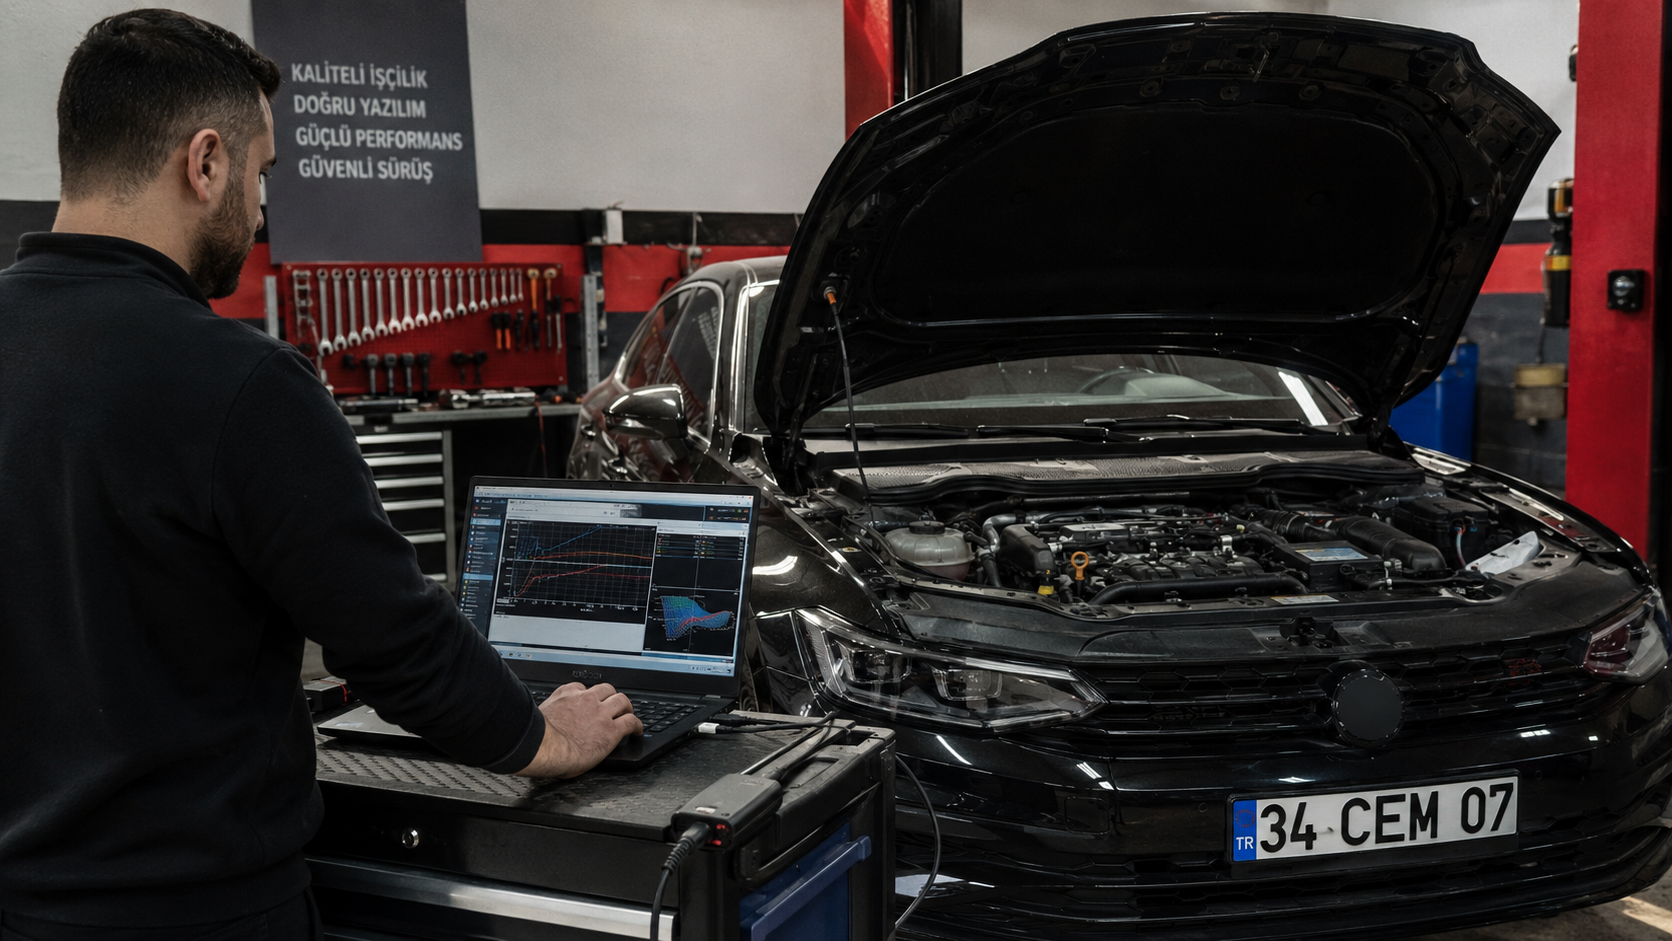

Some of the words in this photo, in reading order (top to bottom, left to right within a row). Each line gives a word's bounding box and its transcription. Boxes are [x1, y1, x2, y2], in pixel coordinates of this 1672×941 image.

[291, 60, 365, 85] KALİTELİ
[370, 63, 428, 91] İŞÇİLİK
[294, 91, 356, 116] DOĞRU
[359, 97, 427, 118] YAZILIM
[296, 123, 351, 151] GÜÇLÜ
[356, 129, 463, 151] PERFORMANS
[299, 155, 373, 179] GÜVENLİ
[377, 157, 433, 184] SÜRÜŞ
[1260, 801, 1317, 853] 34
[1341, 790, 1439, 846] CEM
[1460, 782, 1514, 833] 07
[1236, 836, 1254, 851] TR
